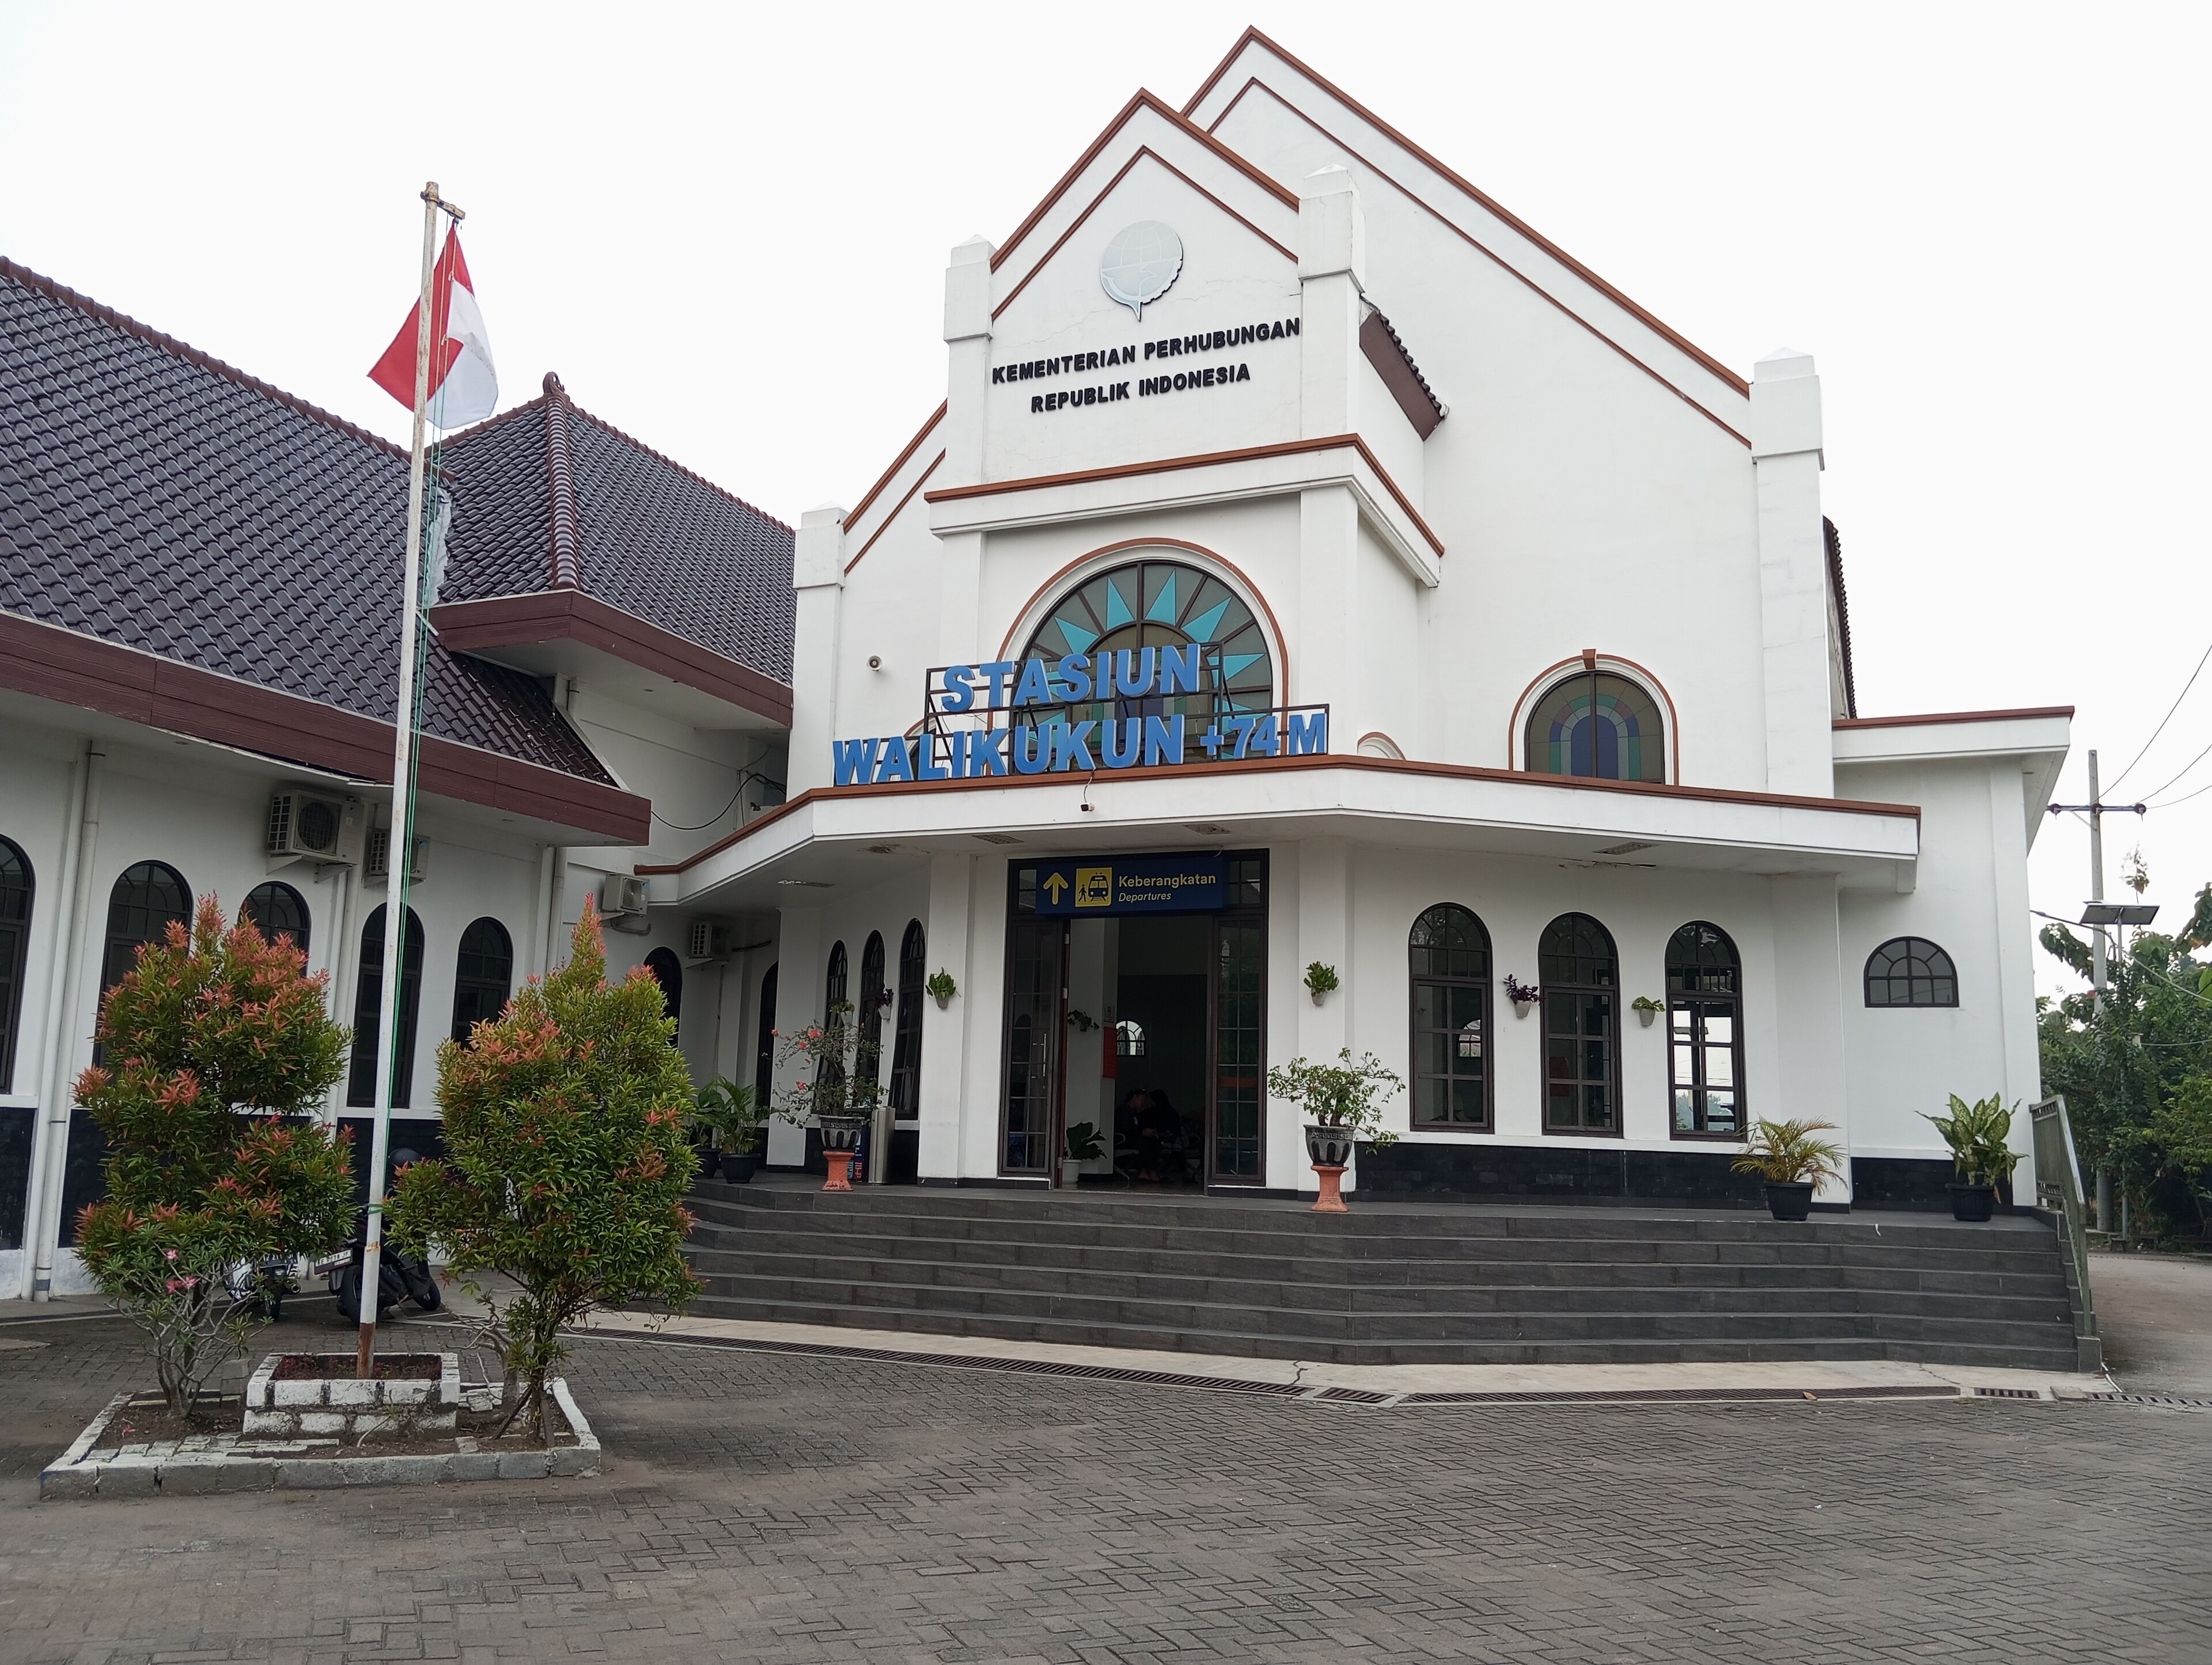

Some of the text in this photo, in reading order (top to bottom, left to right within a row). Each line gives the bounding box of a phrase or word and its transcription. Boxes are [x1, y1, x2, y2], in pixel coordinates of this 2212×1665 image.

[992, 317, 1300, 385] KEMENTERIAN PERHUBUNGAN
[1031, 363, 1251, 413] REPUBLIK INDONESIA
[941, 643, 1200, 712] STASIUN
[832, 714, 1185, 786] WALIKUKUN
[1118, 892, 1172, 903] Departures
[1119, 873, 1216, 889] Keberangkatan
